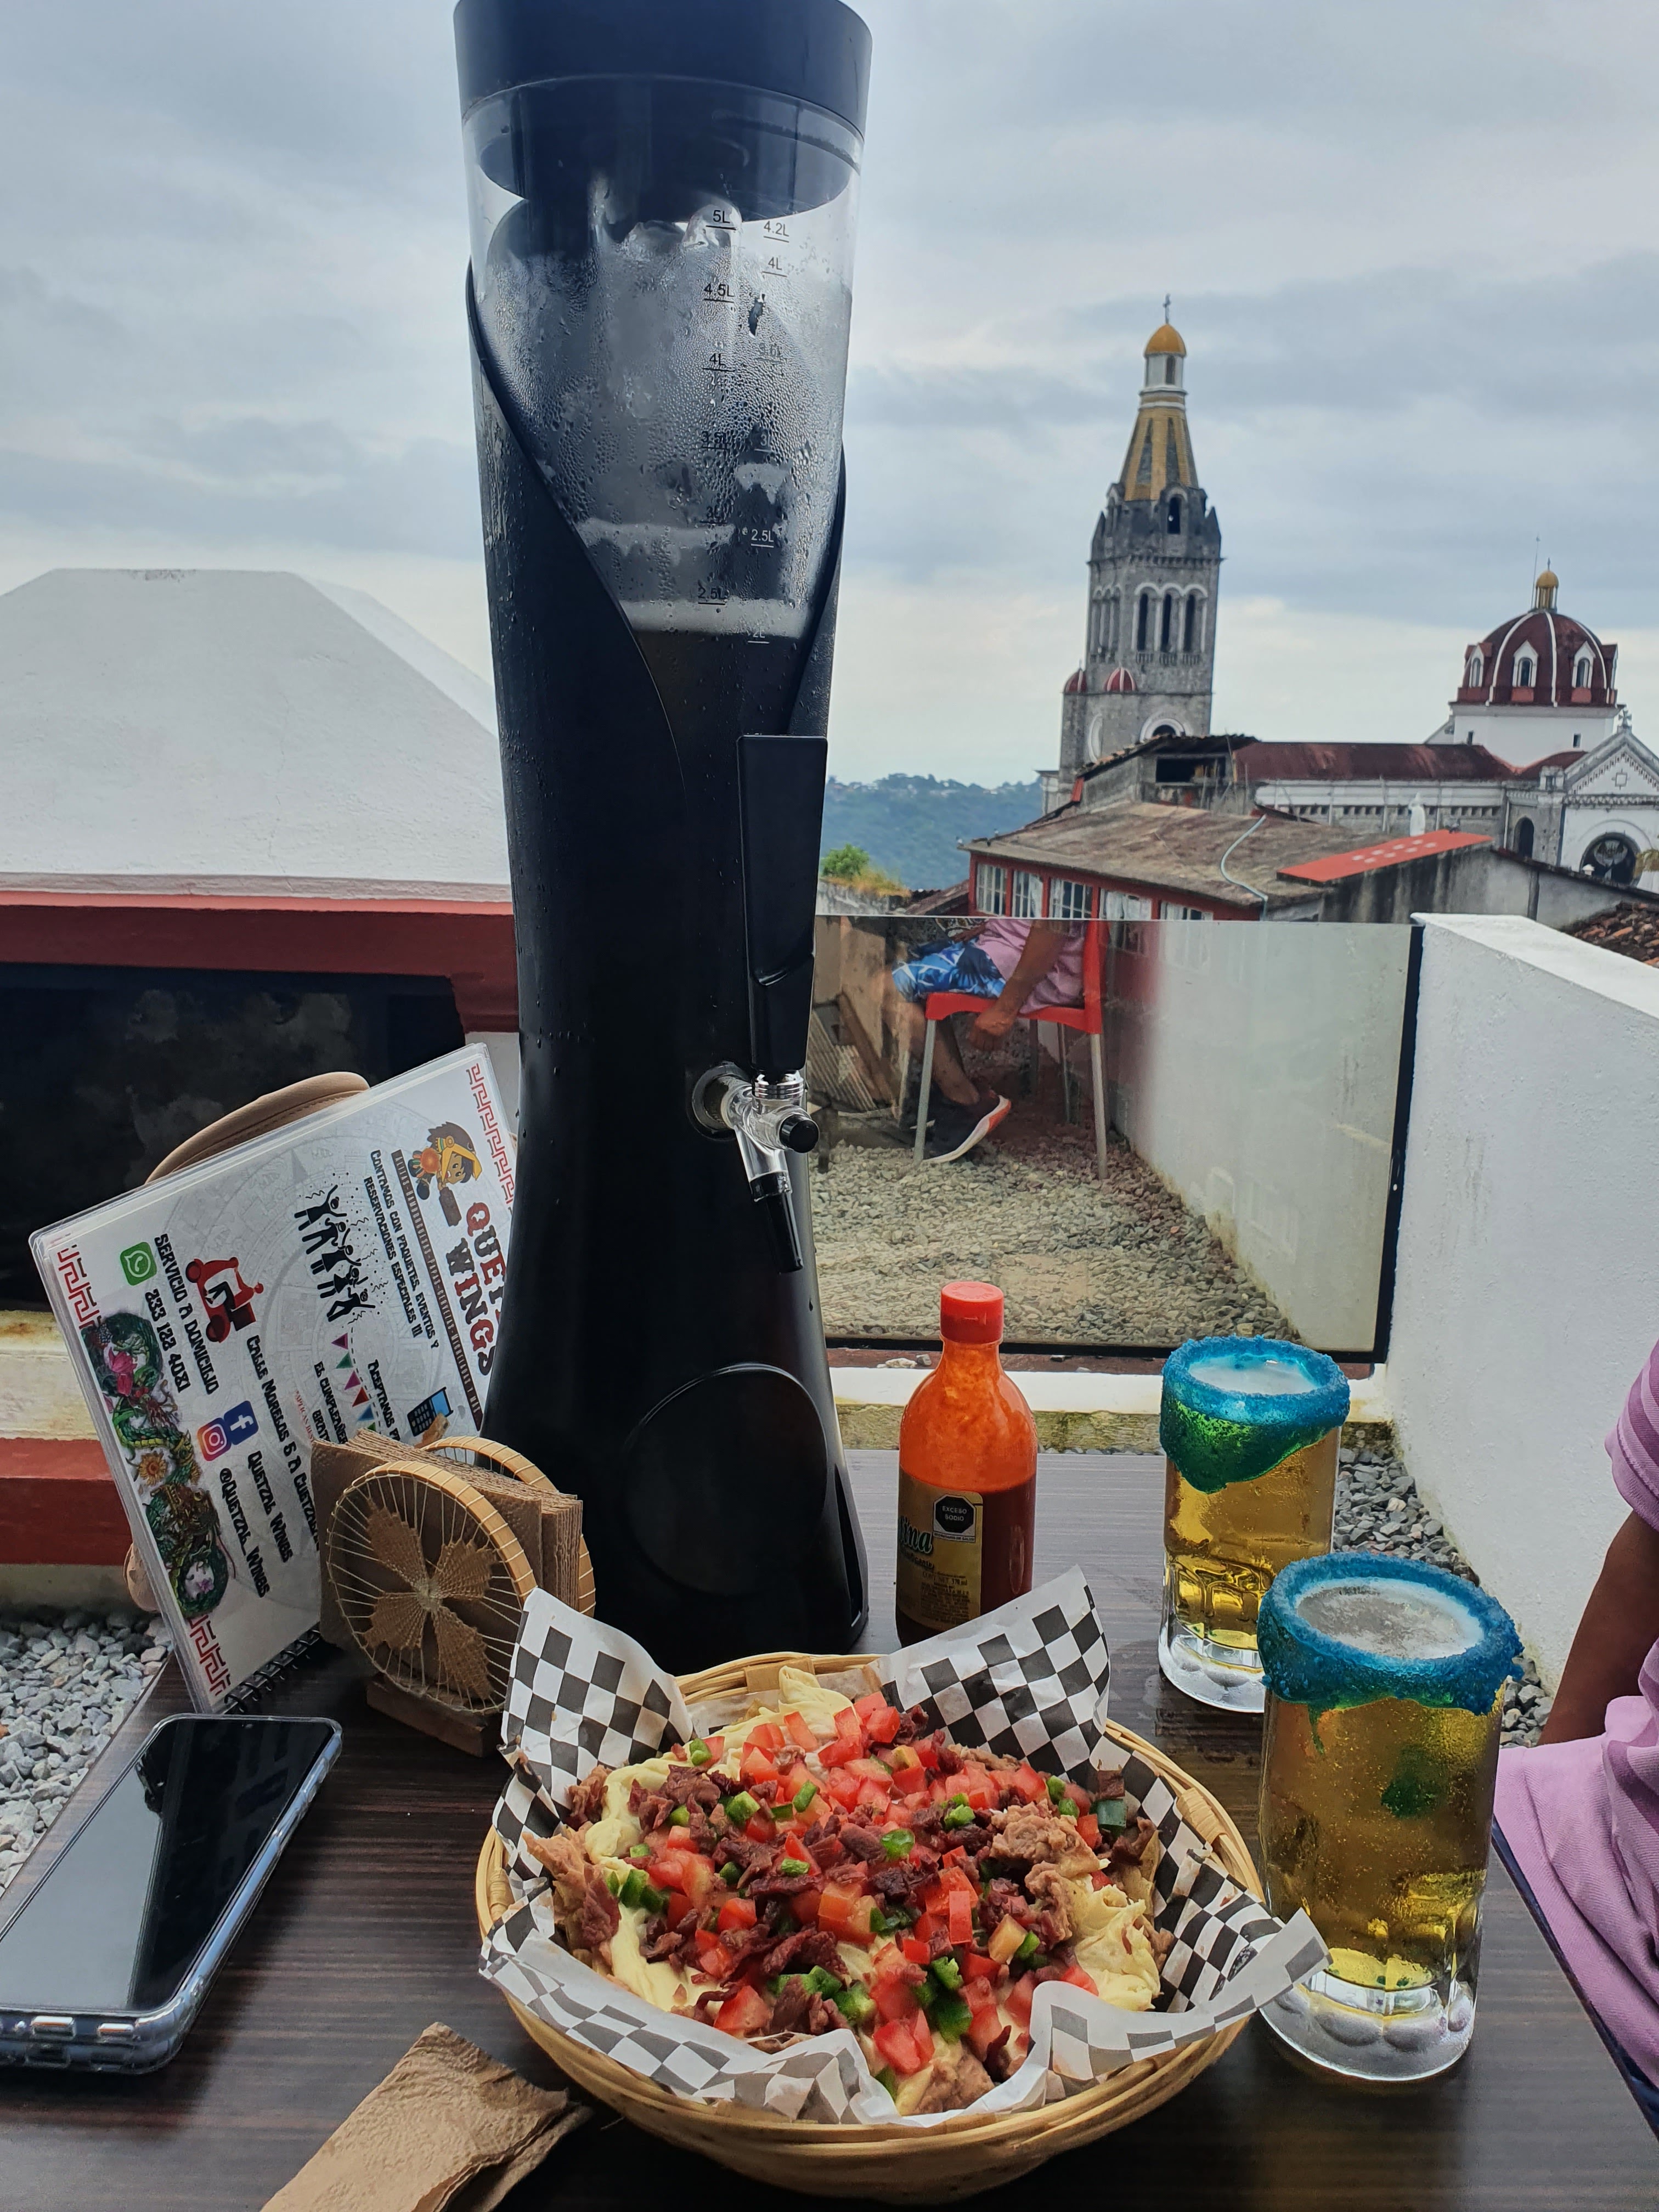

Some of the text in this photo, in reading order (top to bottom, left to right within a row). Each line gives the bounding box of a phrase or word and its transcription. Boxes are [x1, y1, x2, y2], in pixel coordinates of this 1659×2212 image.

[713, 210, 731, 224] 5L
[764, 221, 789, 237] 4.2L
[768, 257, 782, 270] 4L
[704, 283, 735, 297] 4.5L
[709, 353, 726, 366] 4L
[751, 530, 774, 543] 2.5L
[698, 586, 725, 599] 2.5L
[364, 1176, 396, 1260] RESERVACIONES
[391, 1261, 416, 1323] ESPECIALES
[389, 1211, 402, 1233] CON
[415, 1291, 435, 1339] EVENTOS
[431, 1339, 439, 1348] Y
[154, 1233, 219, 1395] SERVICIO A DOMICILIO
[144, 1288, 190, 1393] 233 122 4081
[287, 1455, 301, 1474] A
[942, 1506, 967, 1514] EXCESO
